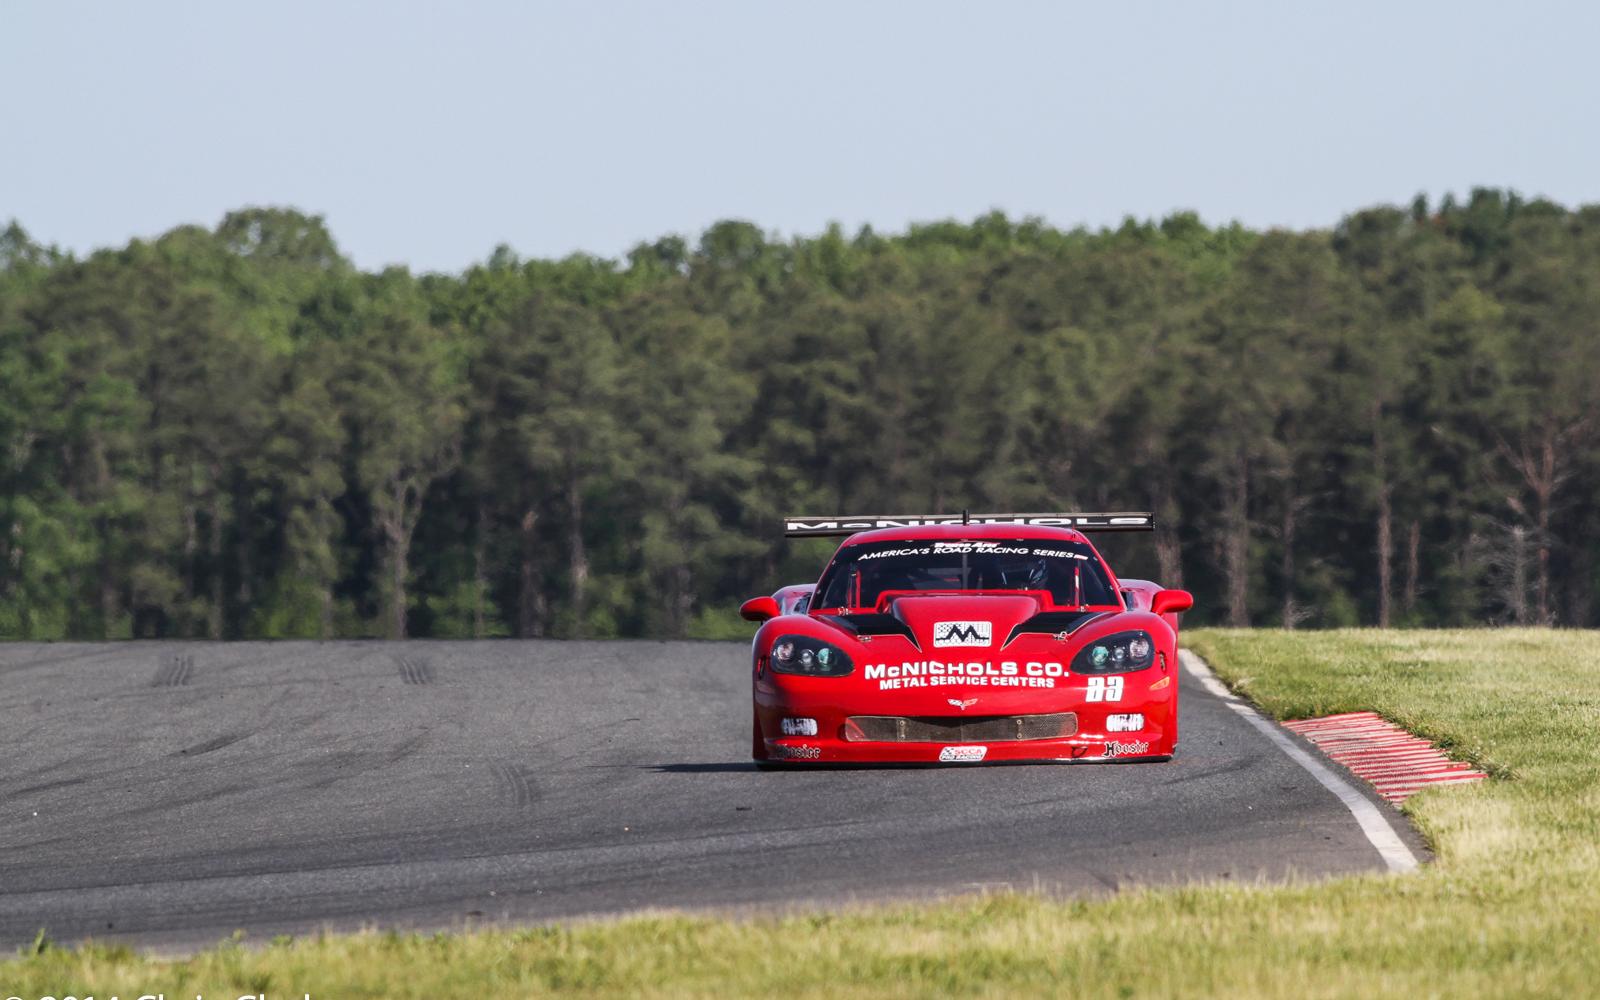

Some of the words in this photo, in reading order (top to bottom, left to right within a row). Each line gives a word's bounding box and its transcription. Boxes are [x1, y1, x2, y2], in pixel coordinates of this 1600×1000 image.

[858, 547, 930, 561] AMERICA'S
[976, 547, 1029, 555] RACING
[1032, 548, 1075, 558] SERIES
[864, 661, 1018, 680] McNICHOLS
[1026, 662, 1069, 678] CO.
[879, 677, 927, 690] METAL
[929, 676, 987, 687] SERVICE
[990, 677, 1054, 688] CENTERS
